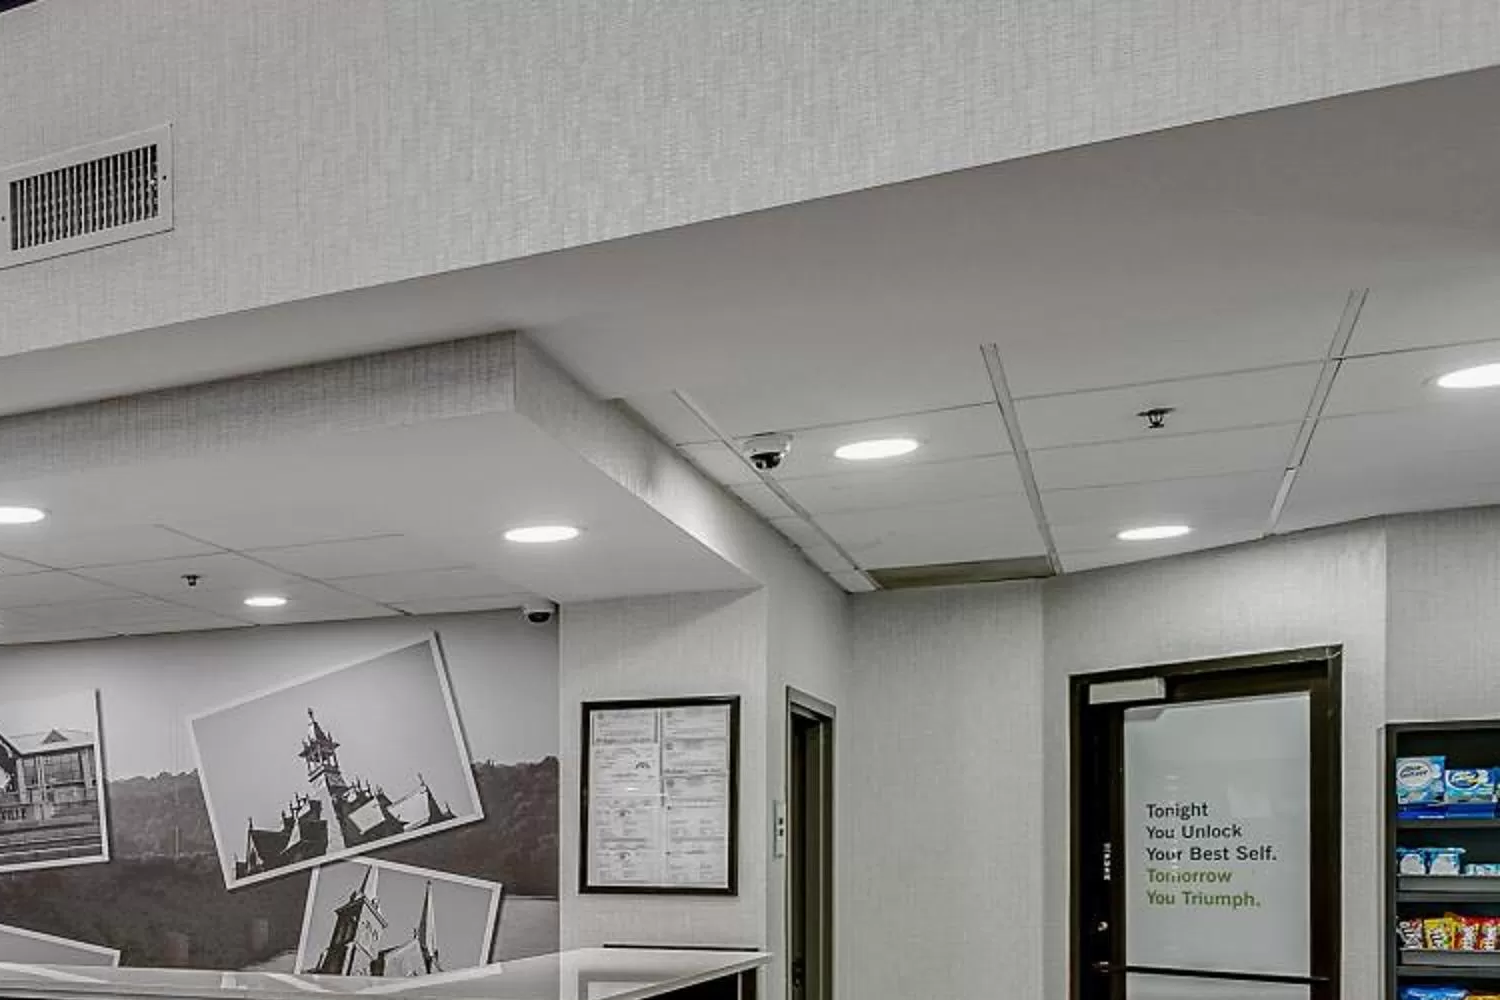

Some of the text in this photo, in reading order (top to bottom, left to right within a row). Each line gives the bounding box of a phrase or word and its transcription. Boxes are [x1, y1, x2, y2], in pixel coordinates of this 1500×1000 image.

[1146, 802, 1209, 820] Tonight
[1146, 823, 1243, 839] You Unlock
[1146, 844, 1278, 861] Your Best Self.
[1146, 868, 1232, 883] Tomorrow
[1146, 890, 1262, 910] You Triumph.
